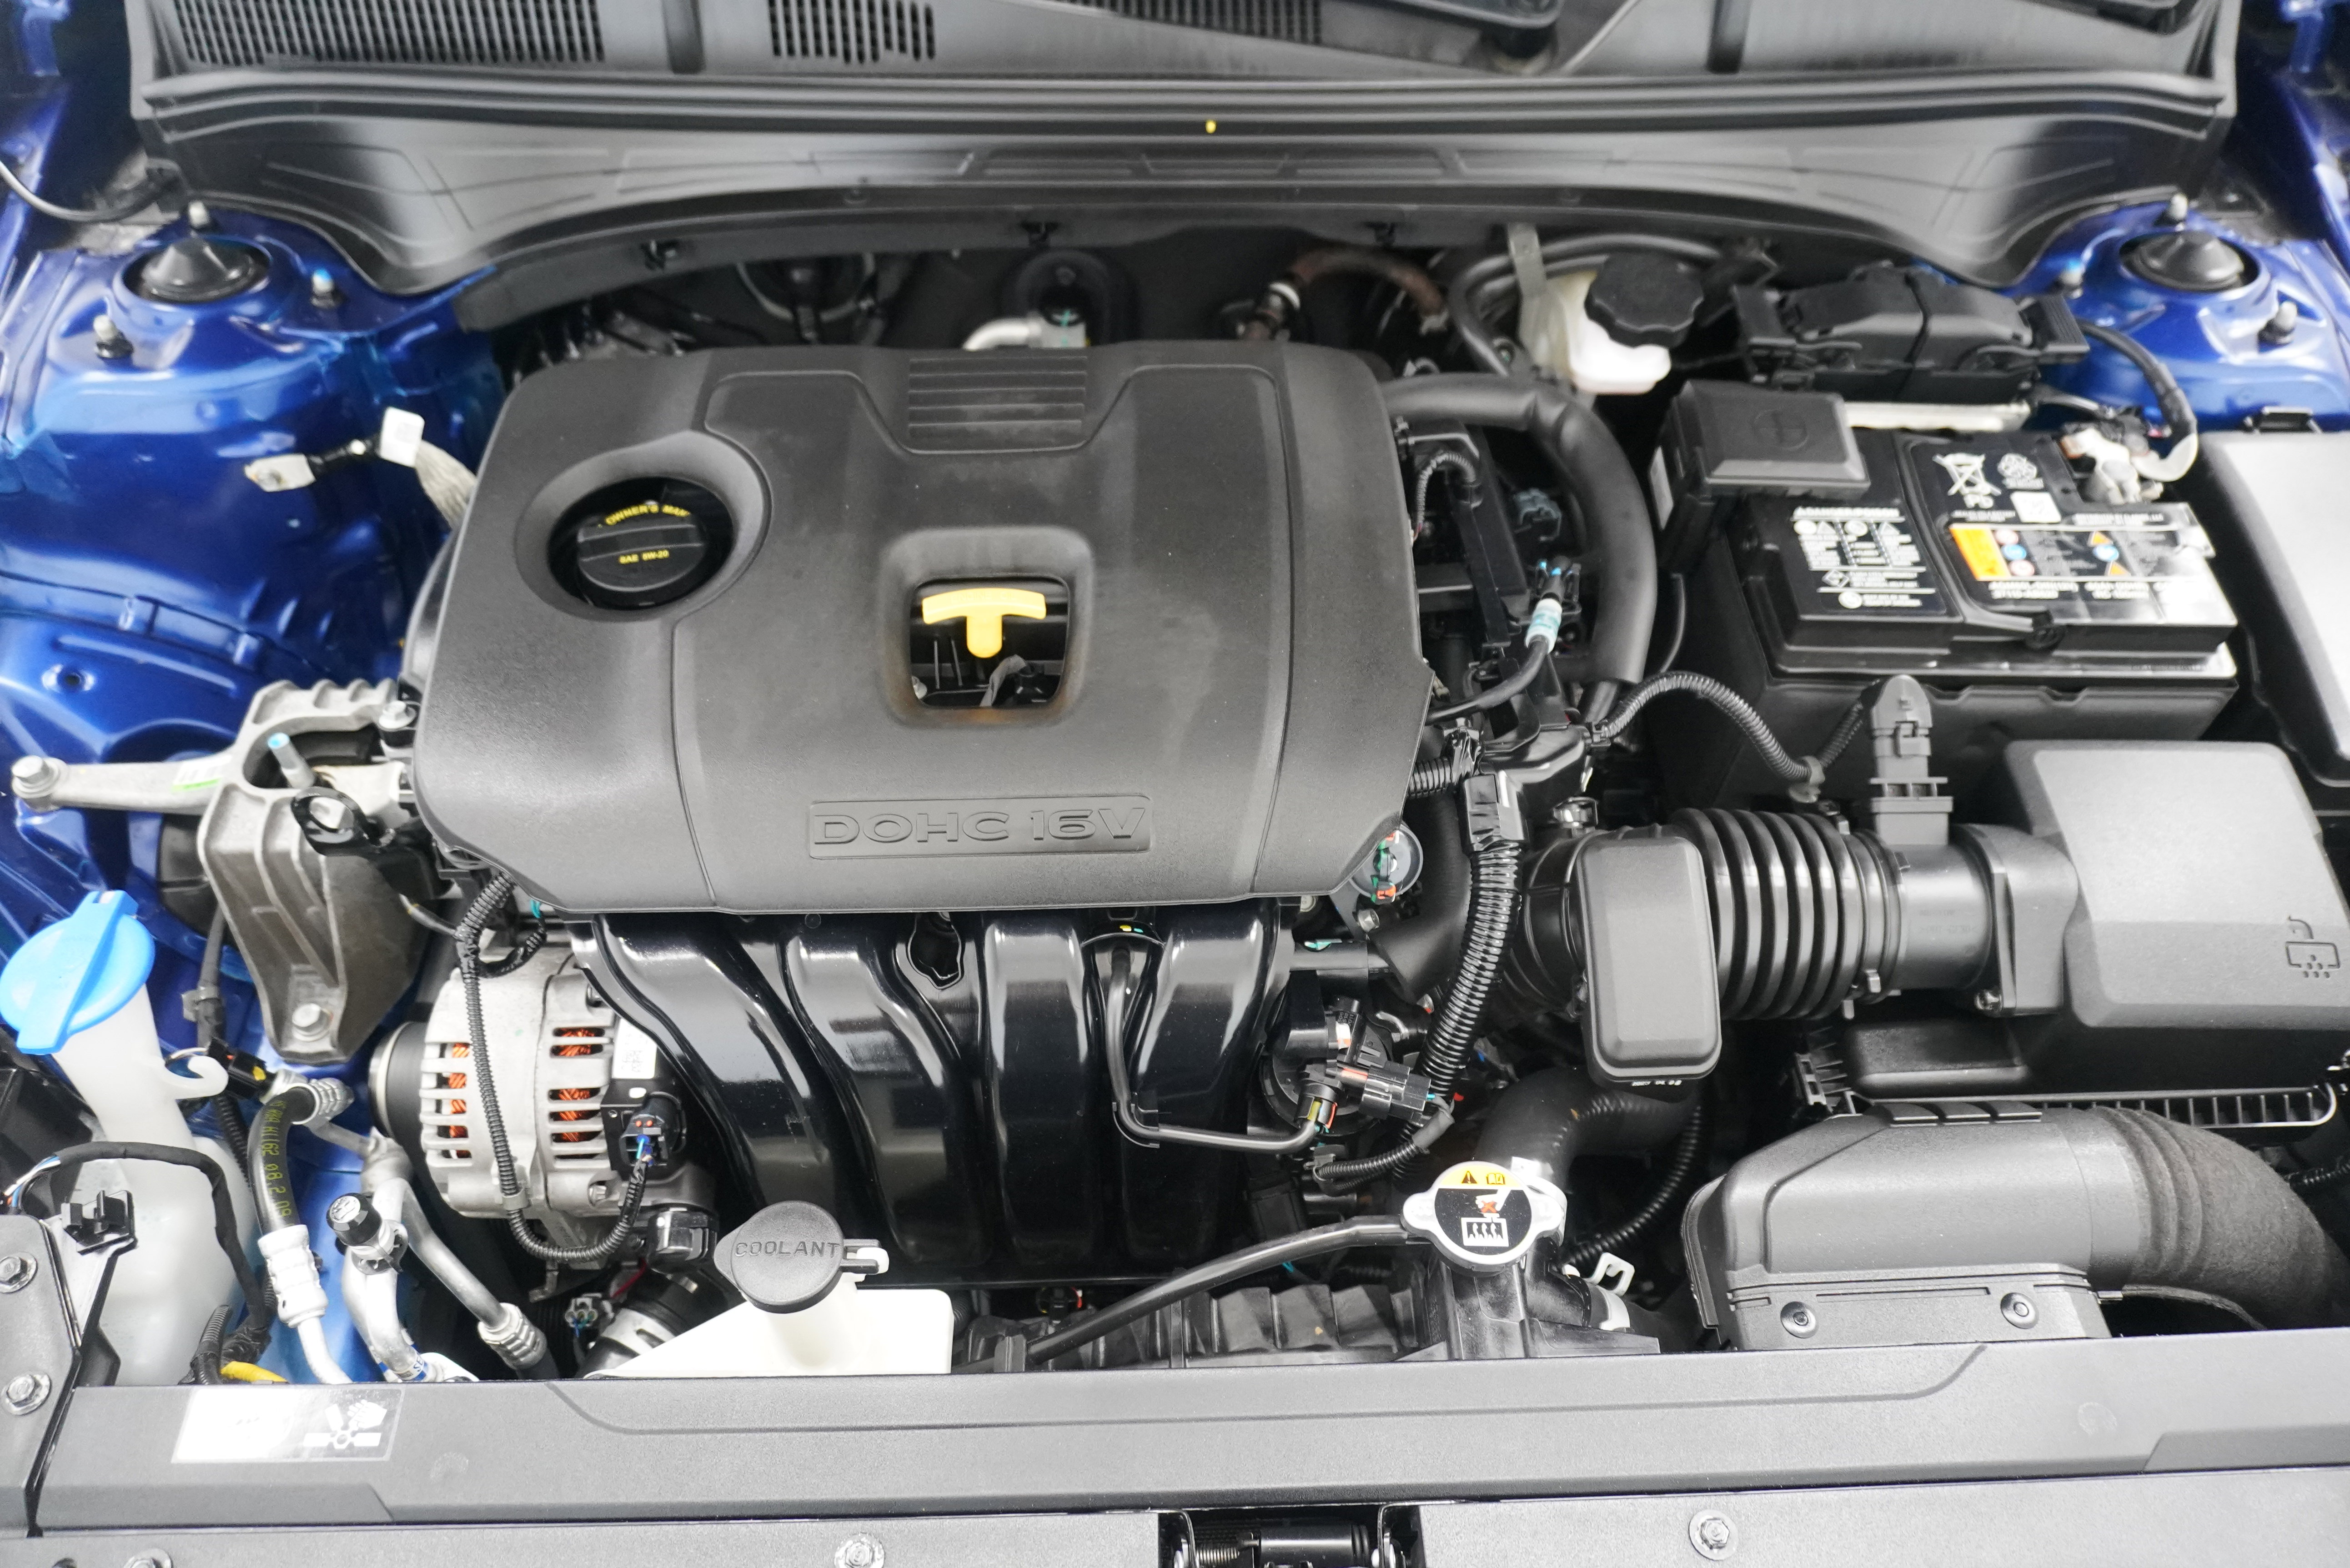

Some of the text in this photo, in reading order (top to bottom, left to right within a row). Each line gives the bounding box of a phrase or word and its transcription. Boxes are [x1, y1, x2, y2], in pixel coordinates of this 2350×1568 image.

[618, 554, 639, 565] SAE
[814, 807, 1146, 845] DOHC 16V
[734, 1241, 841, 1258] COOLANT
